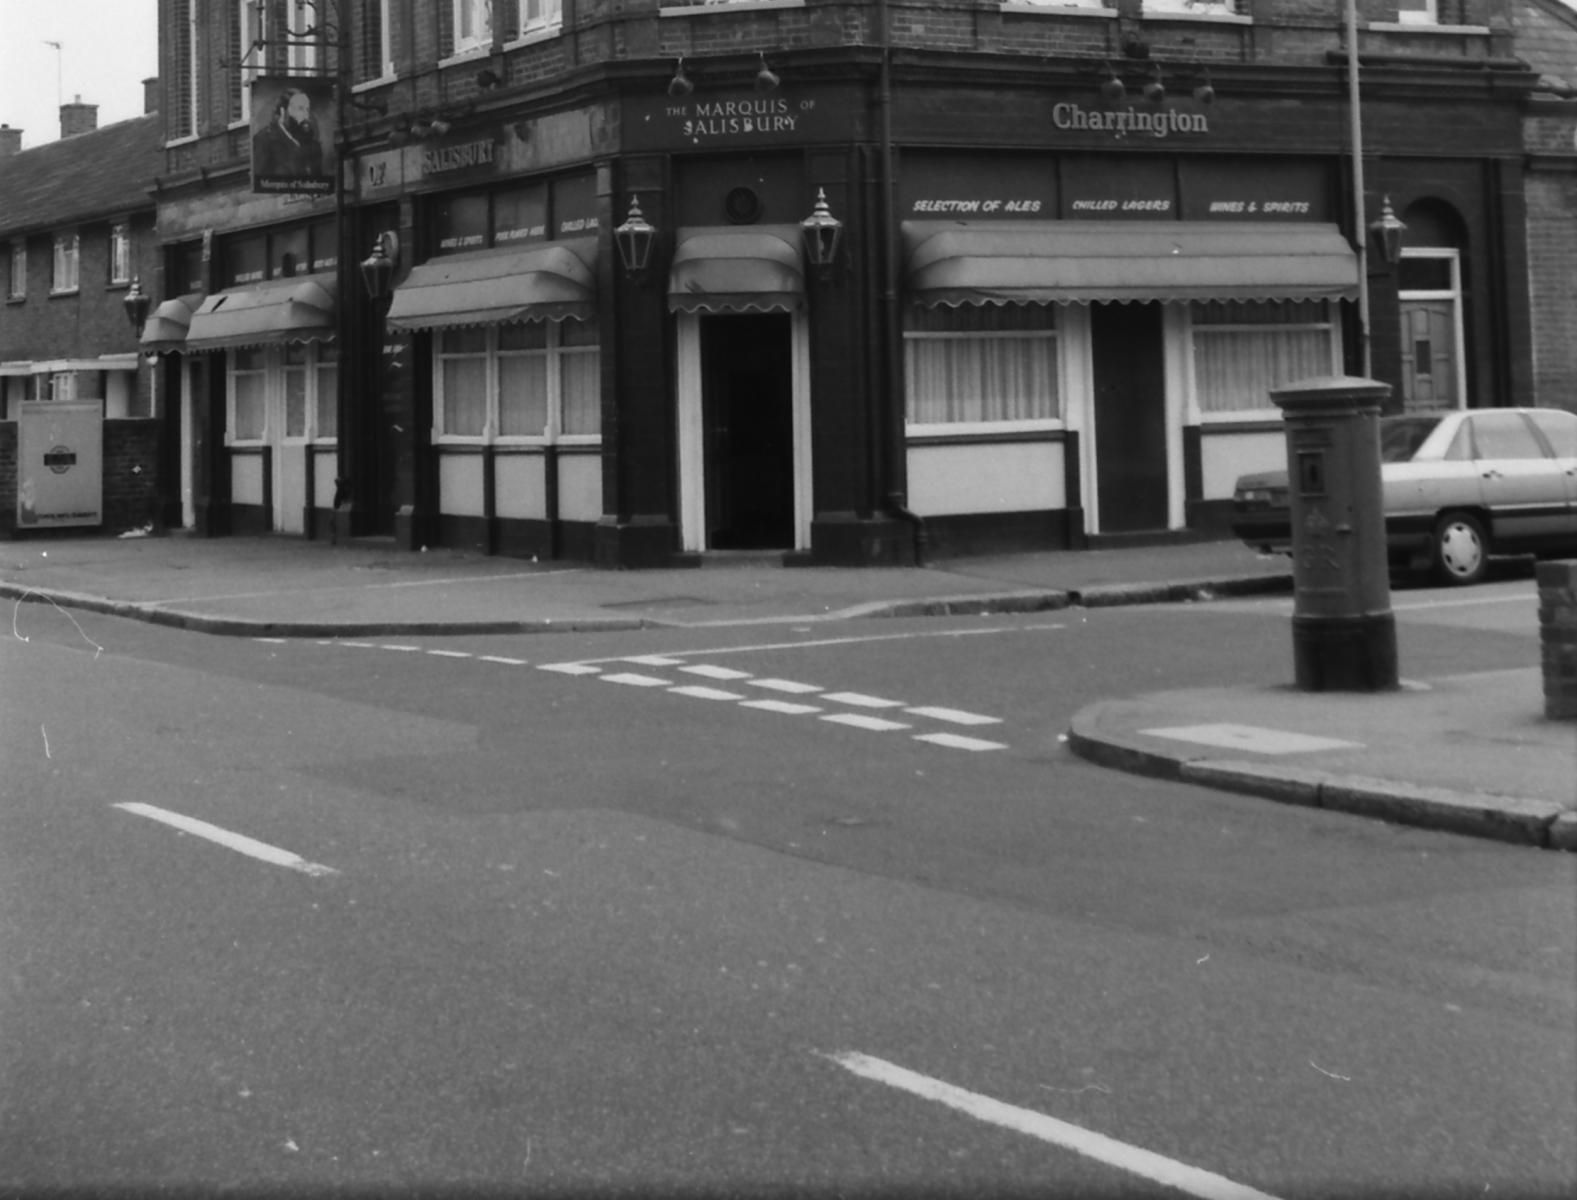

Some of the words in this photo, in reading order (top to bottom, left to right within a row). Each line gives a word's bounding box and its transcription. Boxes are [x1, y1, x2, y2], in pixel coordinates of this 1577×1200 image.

[665, 106, 688, 117] THE
[696, 99, 788, 117] MARQUIS
[800, 100, 816, 110] OF
[683, 114, 799, 136] SALISBURY
[1052, 102, 1209, 137] Charrington
[912, 200, 980, 212] SELECTION
[982, 200, 1002, 211] OF
[1005, 200, 1042, 212] ALES
[1072, 200, 1118, 210] CHILLED
[1122, 200, 1172, 211] LAGERS
[1263, 201, 1310, 212] SPIRITS
